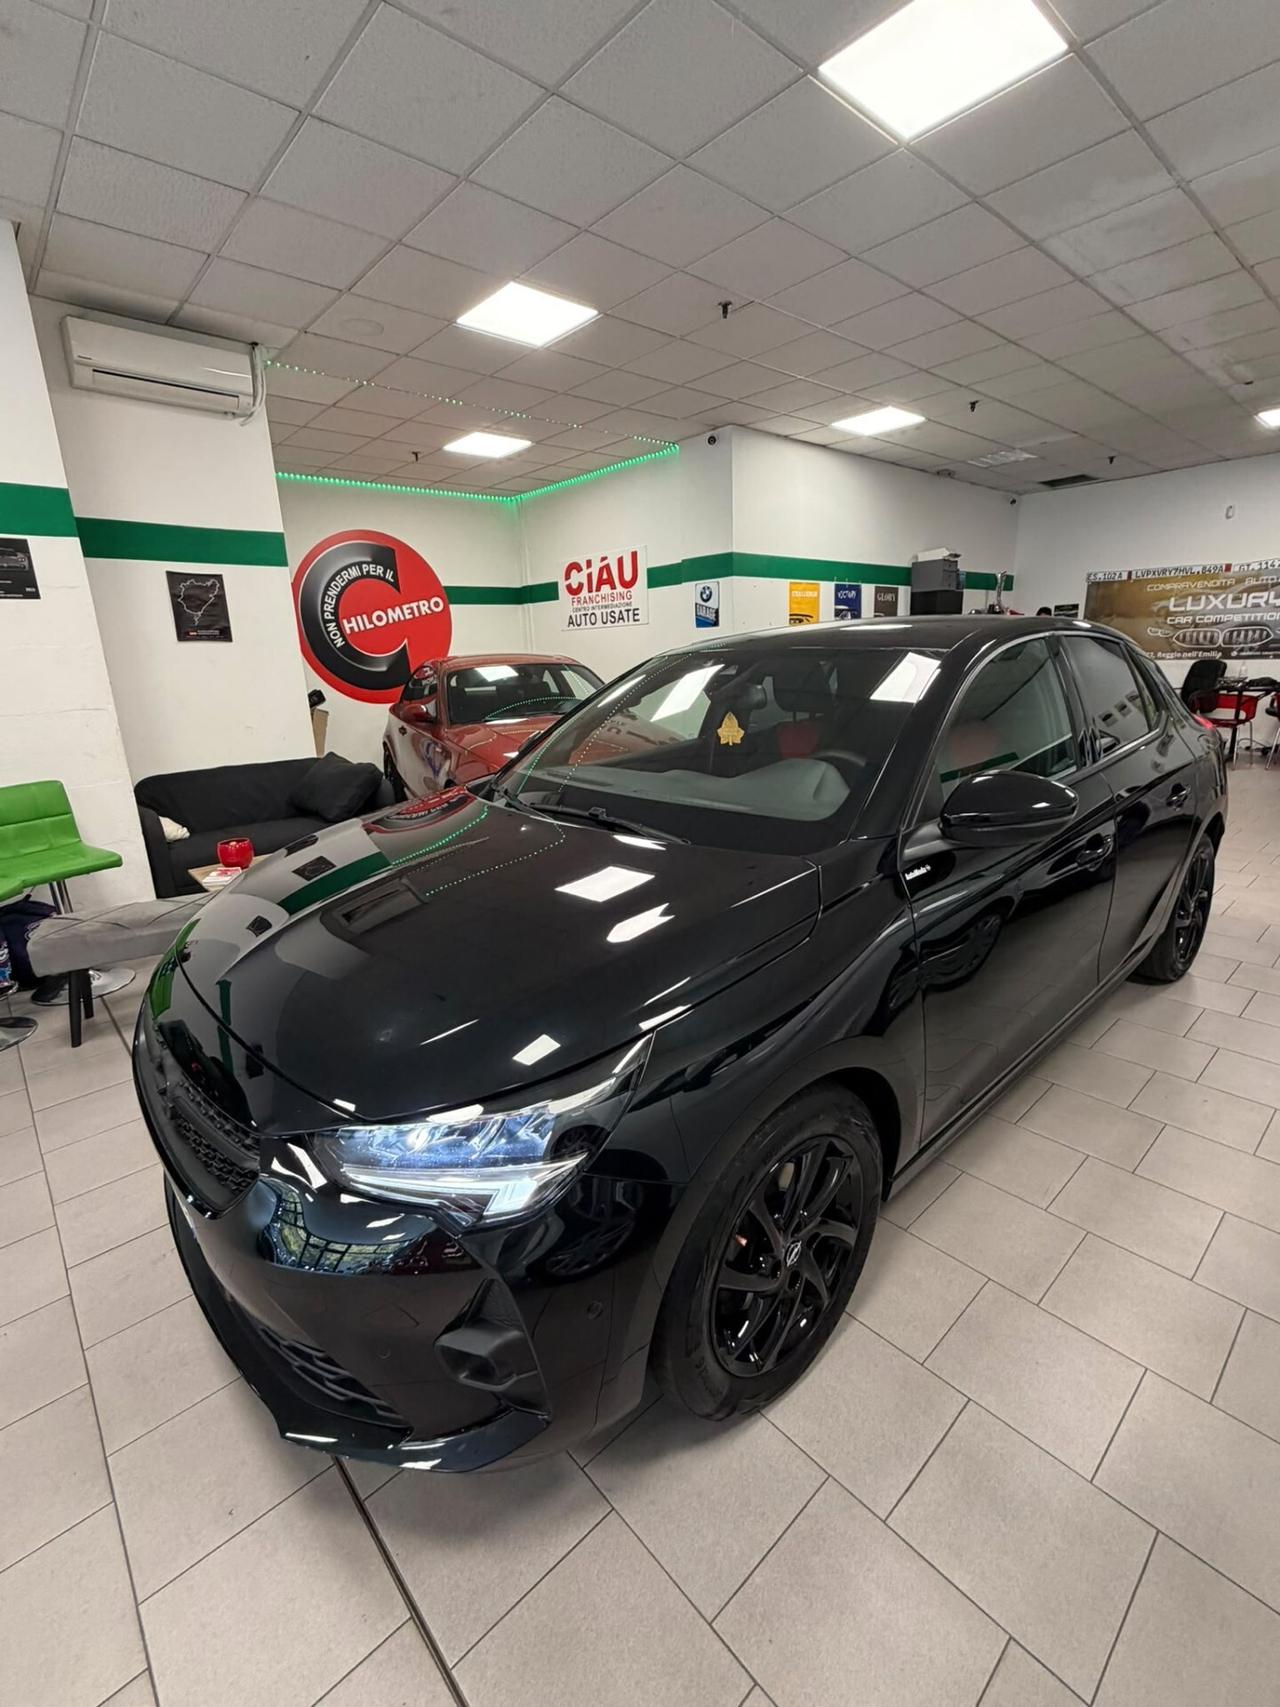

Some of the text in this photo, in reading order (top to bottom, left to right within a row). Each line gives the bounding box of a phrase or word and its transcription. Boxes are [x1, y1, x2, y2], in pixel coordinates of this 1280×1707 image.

[323, 563, 395, 649] NON PRENDERMI PER IL
[571, 590, 633, 606] FRANCHISING
[567, 608, 640, 628] AUTO USATE
[1167, 616, 1193, 625] CAR
